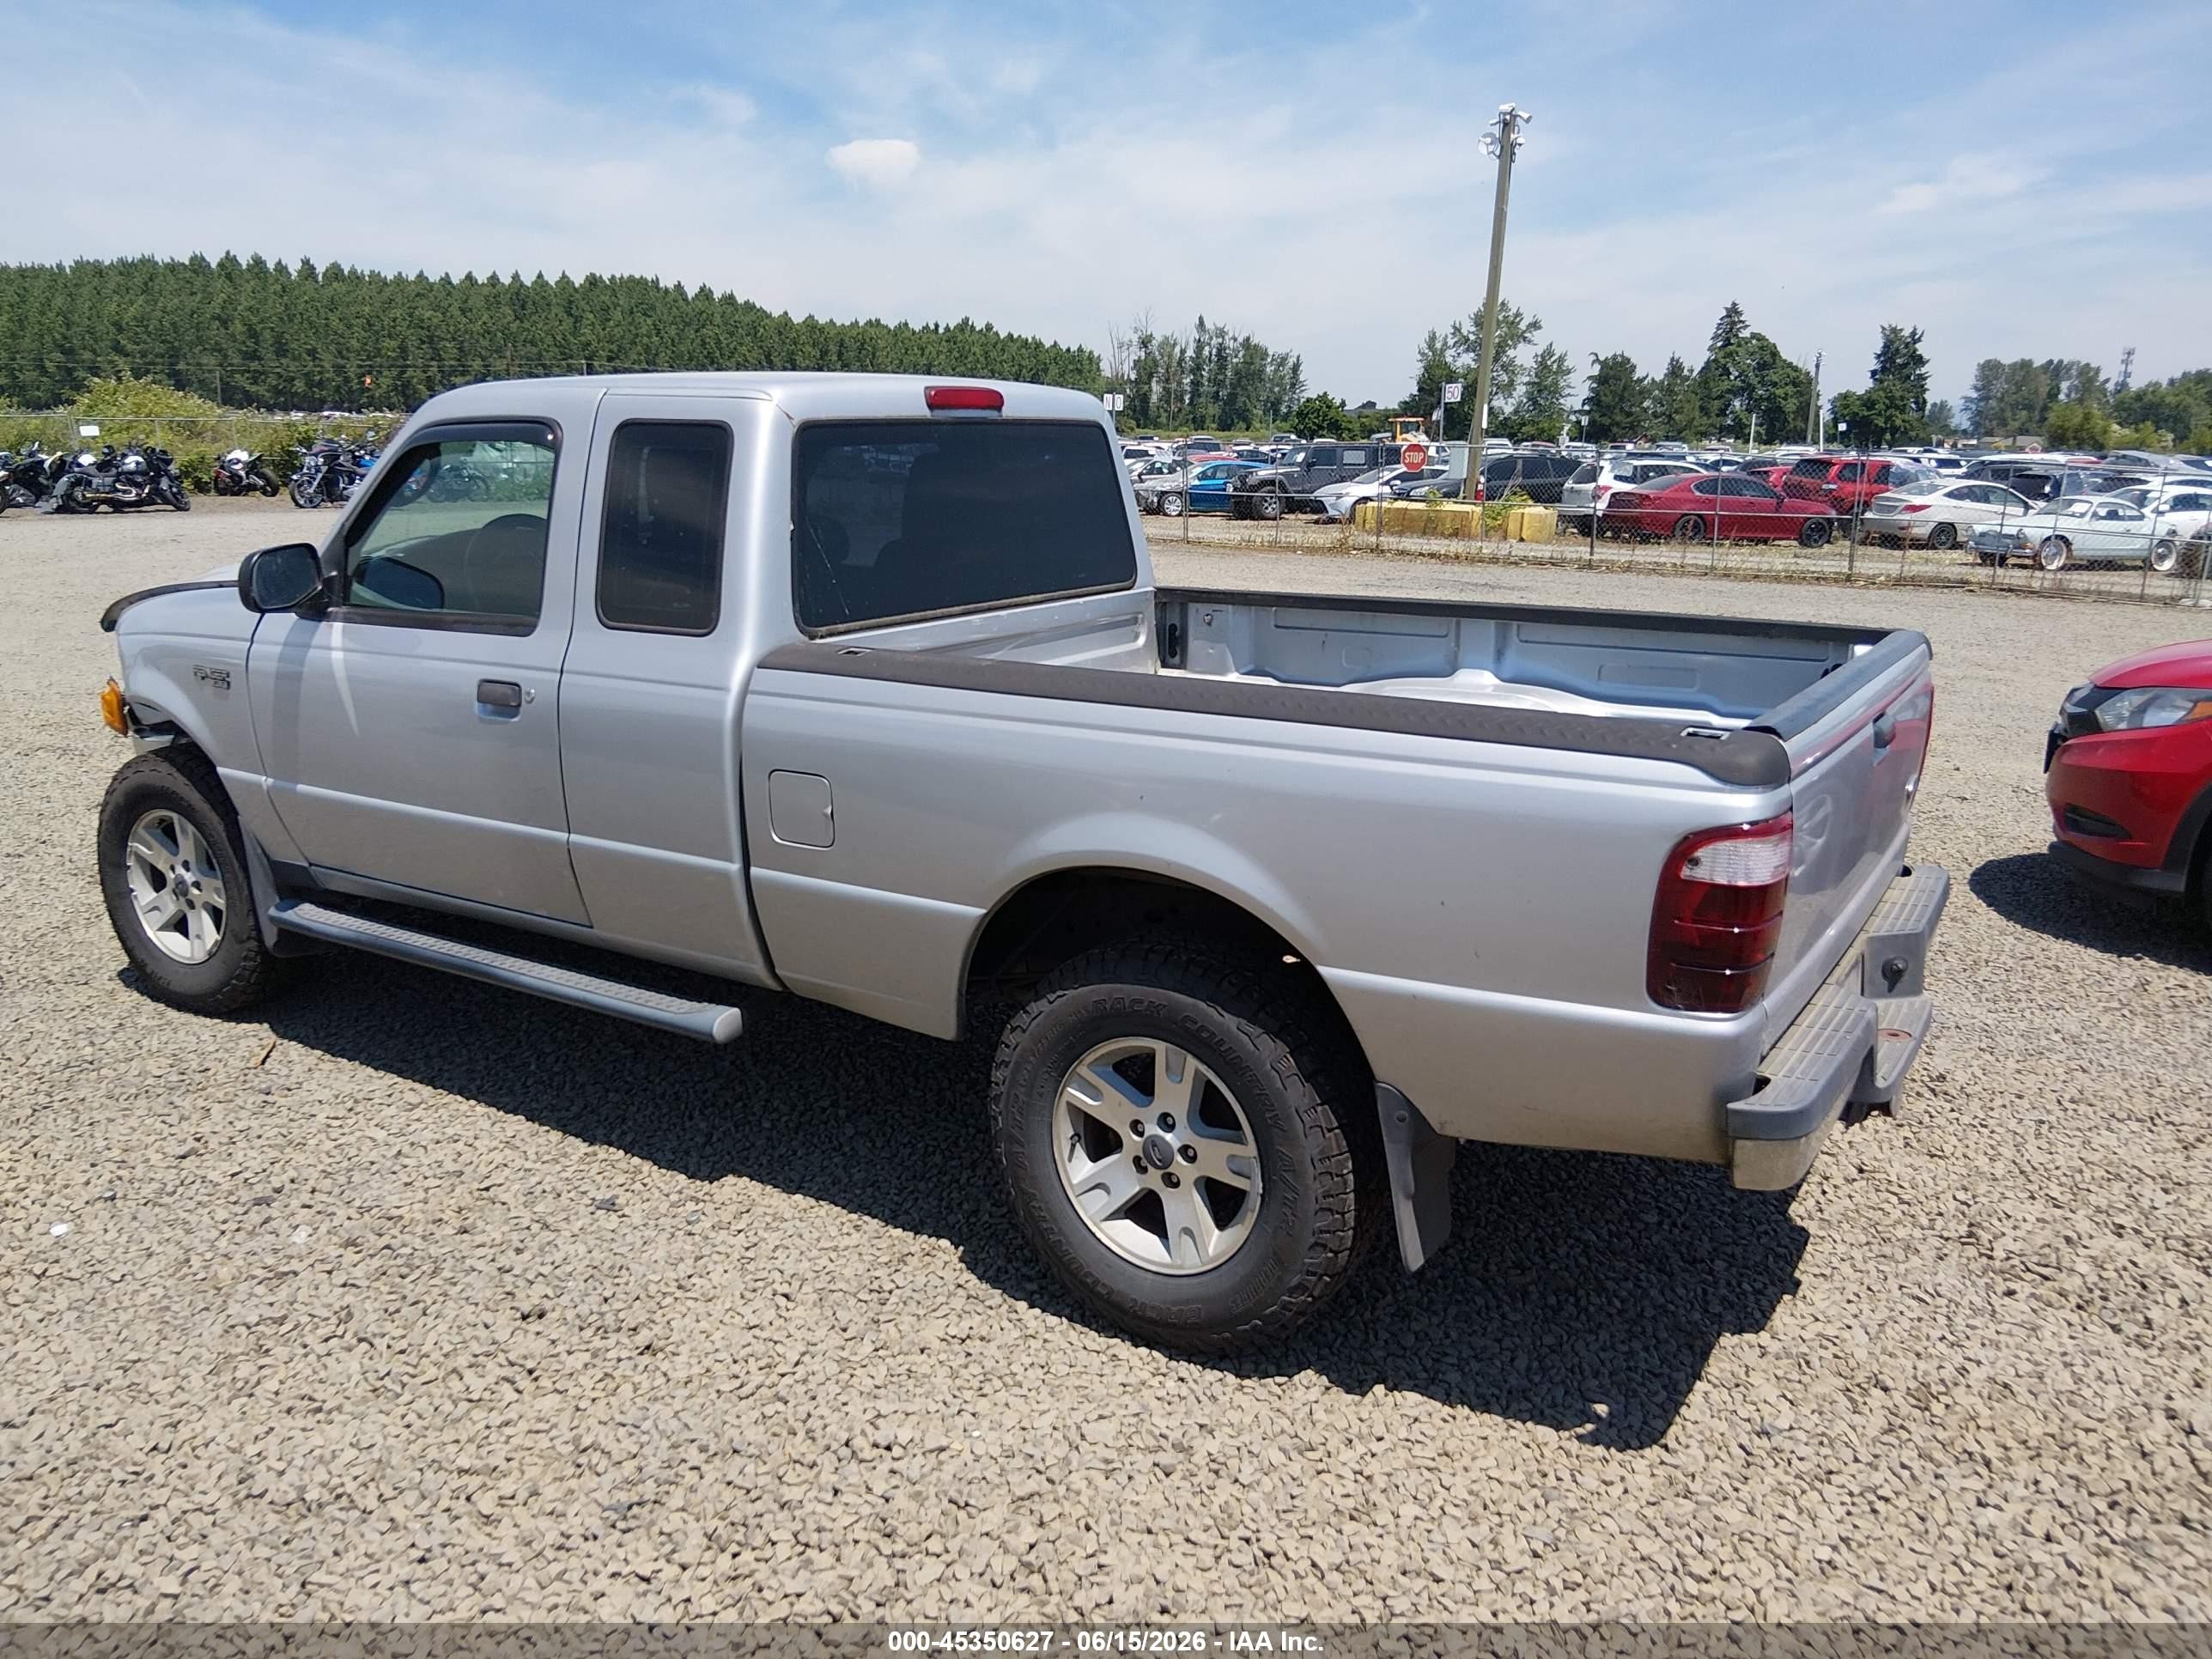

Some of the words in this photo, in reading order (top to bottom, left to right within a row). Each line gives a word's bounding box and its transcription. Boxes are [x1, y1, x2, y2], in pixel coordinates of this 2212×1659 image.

[1446, 386, 1460, 400] 50
[1404, 452, 1424, 464] STOP
[1091, 996, 1169, 1018] BACK
[1180, 1012, 1288, 1133] COUNTRY
